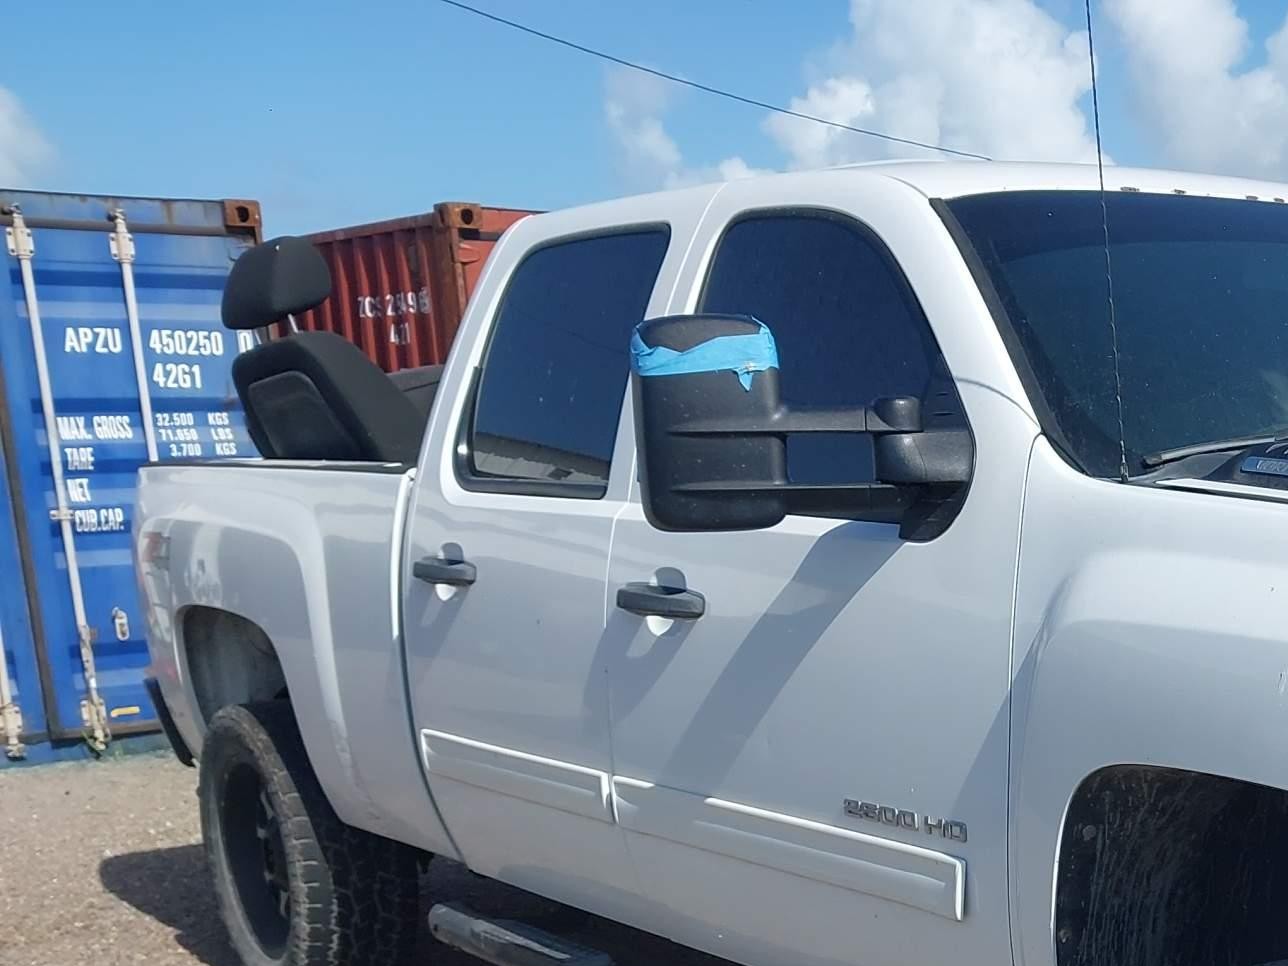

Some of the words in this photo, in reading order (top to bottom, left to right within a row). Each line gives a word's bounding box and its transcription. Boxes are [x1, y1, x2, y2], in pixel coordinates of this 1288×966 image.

[64, 327, 122, 353] APZU
[149, 329, 224, 356] 450250
[153, 363, 202, 388] 42G1
[57, 416, 92, 440] MAX.
[93, 415, 133, 440] GROSS
[155, 412, 194, 426] 32.500
[208, 412, 229, 426] KGS
[64, 448, 95, 471] TARE
[169, 443, 202, 457] 3.700
[215, 442, 237, 456] KGS
[66, 478, 91, 502] NET
[74, 508, 124, 532] CUB.CAP.
[924, 815, 968, 843] HD
